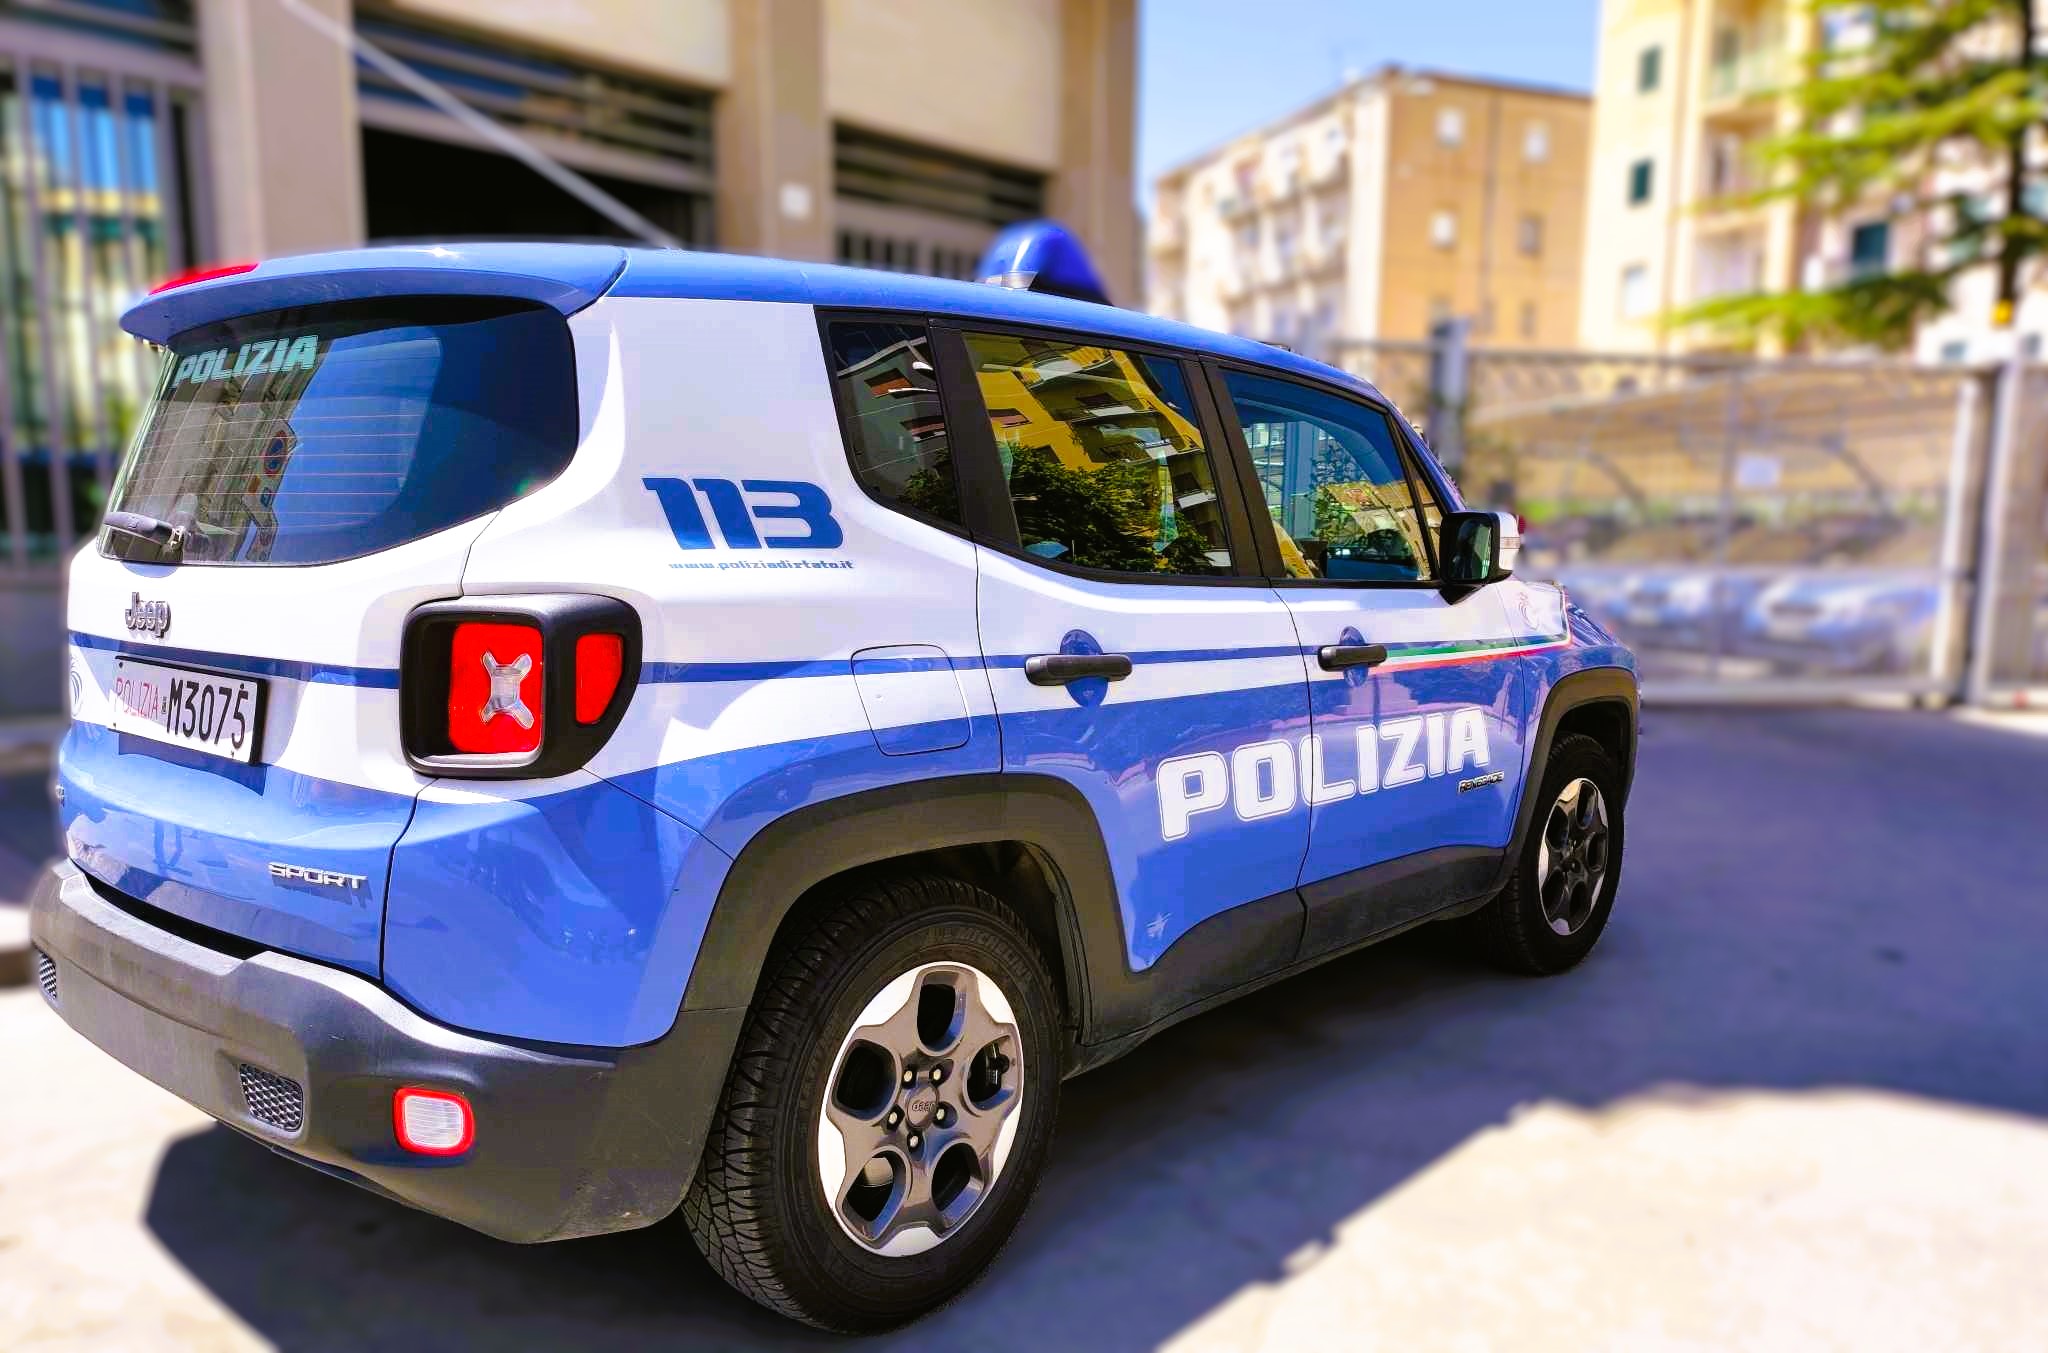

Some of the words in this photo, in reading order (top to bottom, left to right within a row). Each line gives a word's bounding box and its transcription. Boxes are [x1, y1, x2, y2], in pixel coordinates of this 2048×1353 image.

[172, 335, 318, 388] POLIZIA
[641, 477, 844, 550] 113
[125, 591, 171, 638] Jeep
[115, 676, 159, 720] POLIZIA
[166, 677, 248, 749] M3075
[1156, 707, 1491, 842] POLIZIA
[268, 862, 367, 889] SPORT
